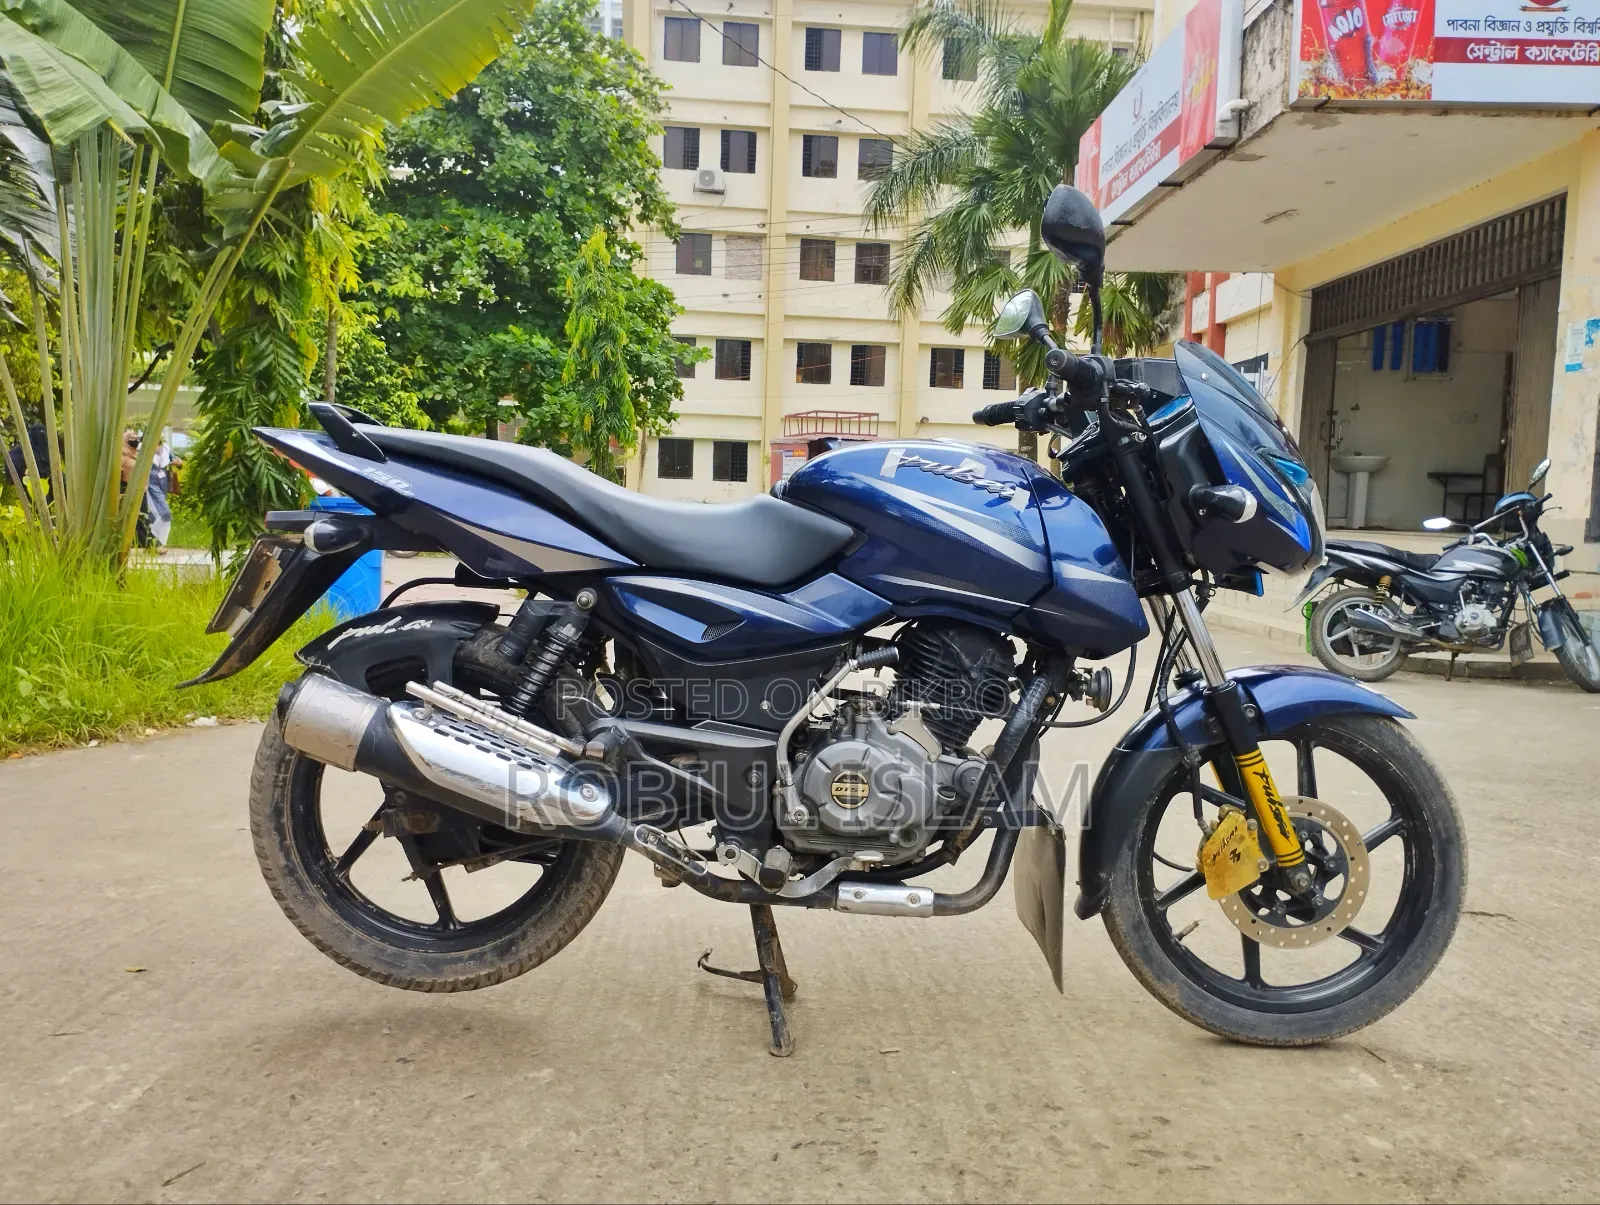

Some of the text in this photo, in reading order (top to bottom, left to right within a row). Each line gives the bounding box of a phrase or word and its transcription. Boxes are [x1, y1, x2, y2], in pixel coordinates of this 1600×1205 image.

[1446, 18, 1481, 32] পাবনা
[1484, 14, 1521, 33] বিজ্ঞান
[1523, 20, 1533, 33] ও
[1535, 16, 1571, 37] প্রযুক্তি
[1466, 40, 1520, 62] সেন্ট্রাল
